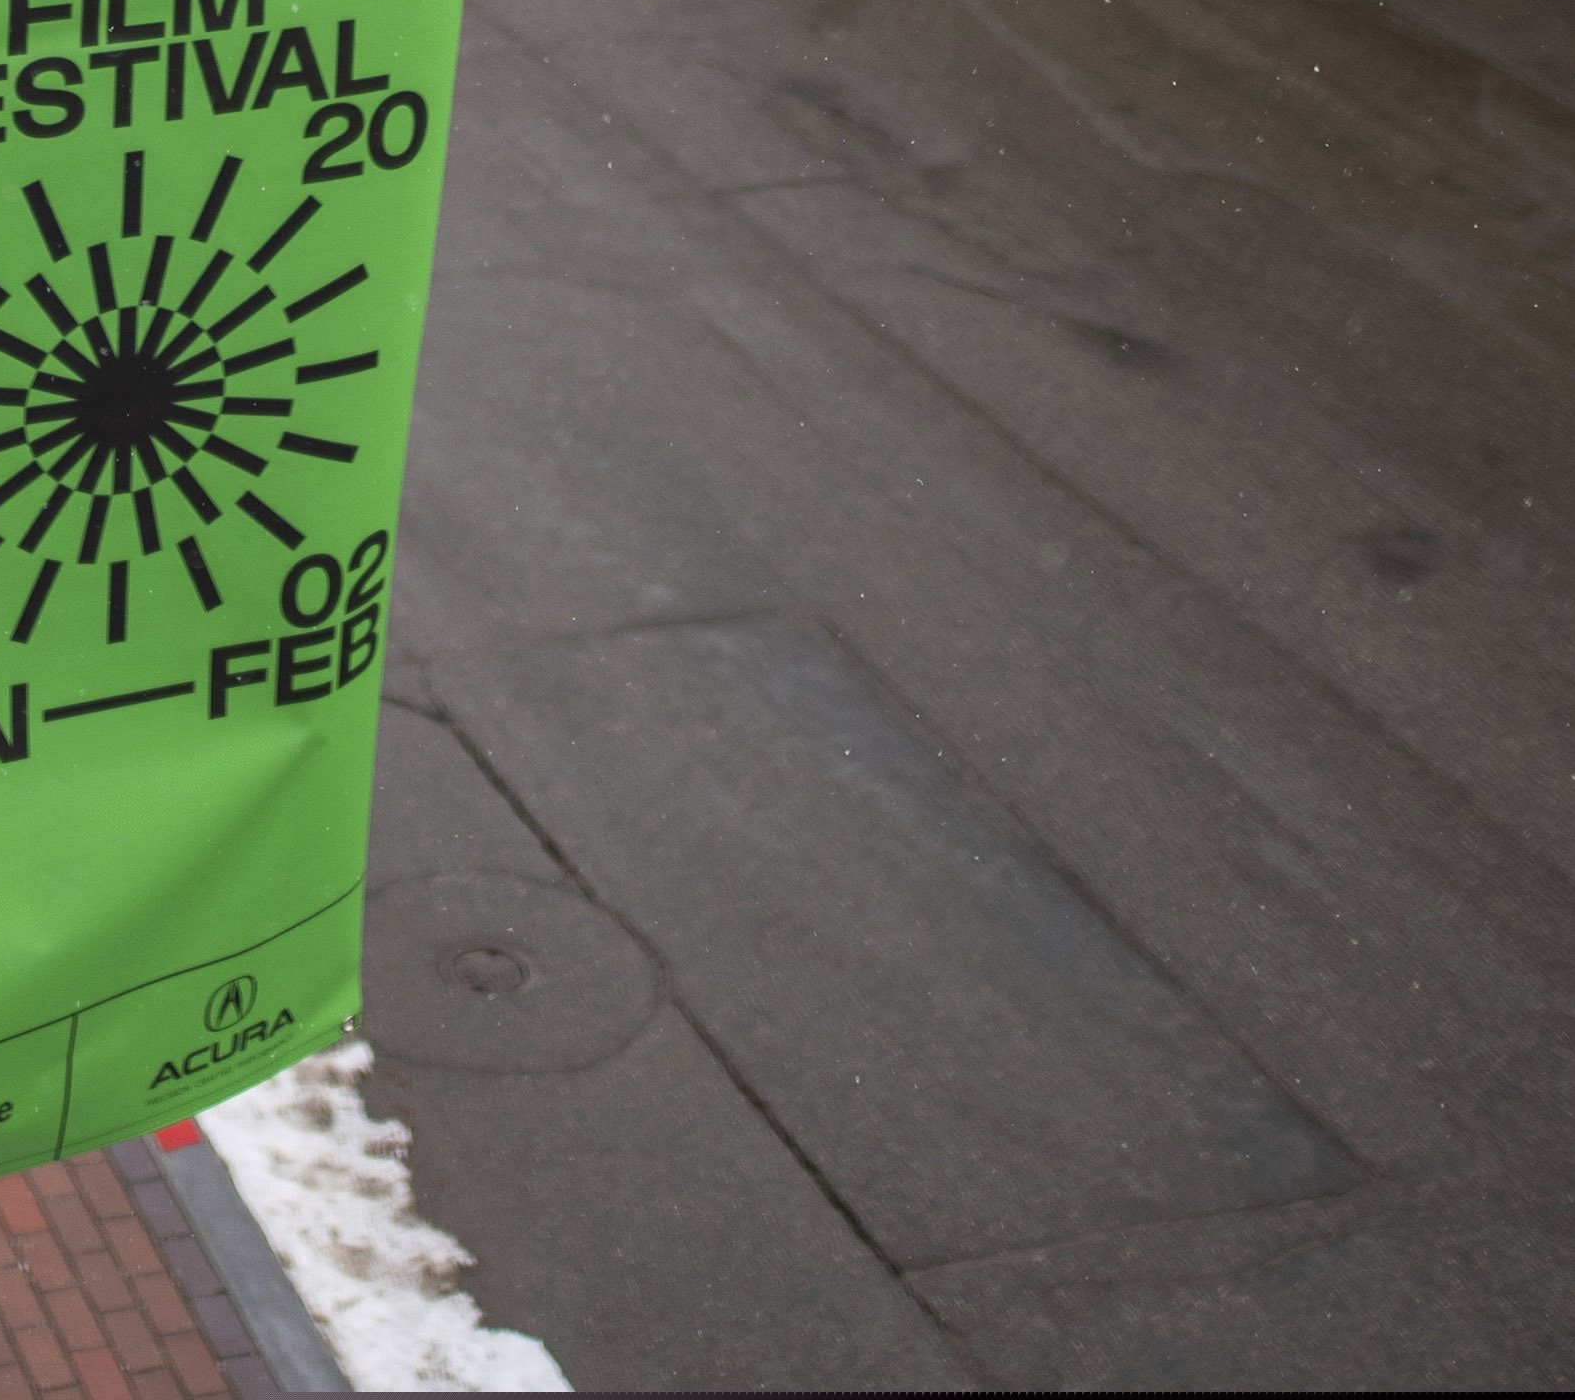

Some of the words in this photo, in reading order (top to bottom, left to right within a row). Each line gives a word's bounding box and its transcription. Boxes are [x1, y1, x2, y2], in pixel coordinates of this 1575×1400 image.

[302, 90, 428, 185] 20
[280, 529, 388, 629] 02
[209, 602, 379, 720] FEB
[149, 1008, 295, 1089] ACURA
